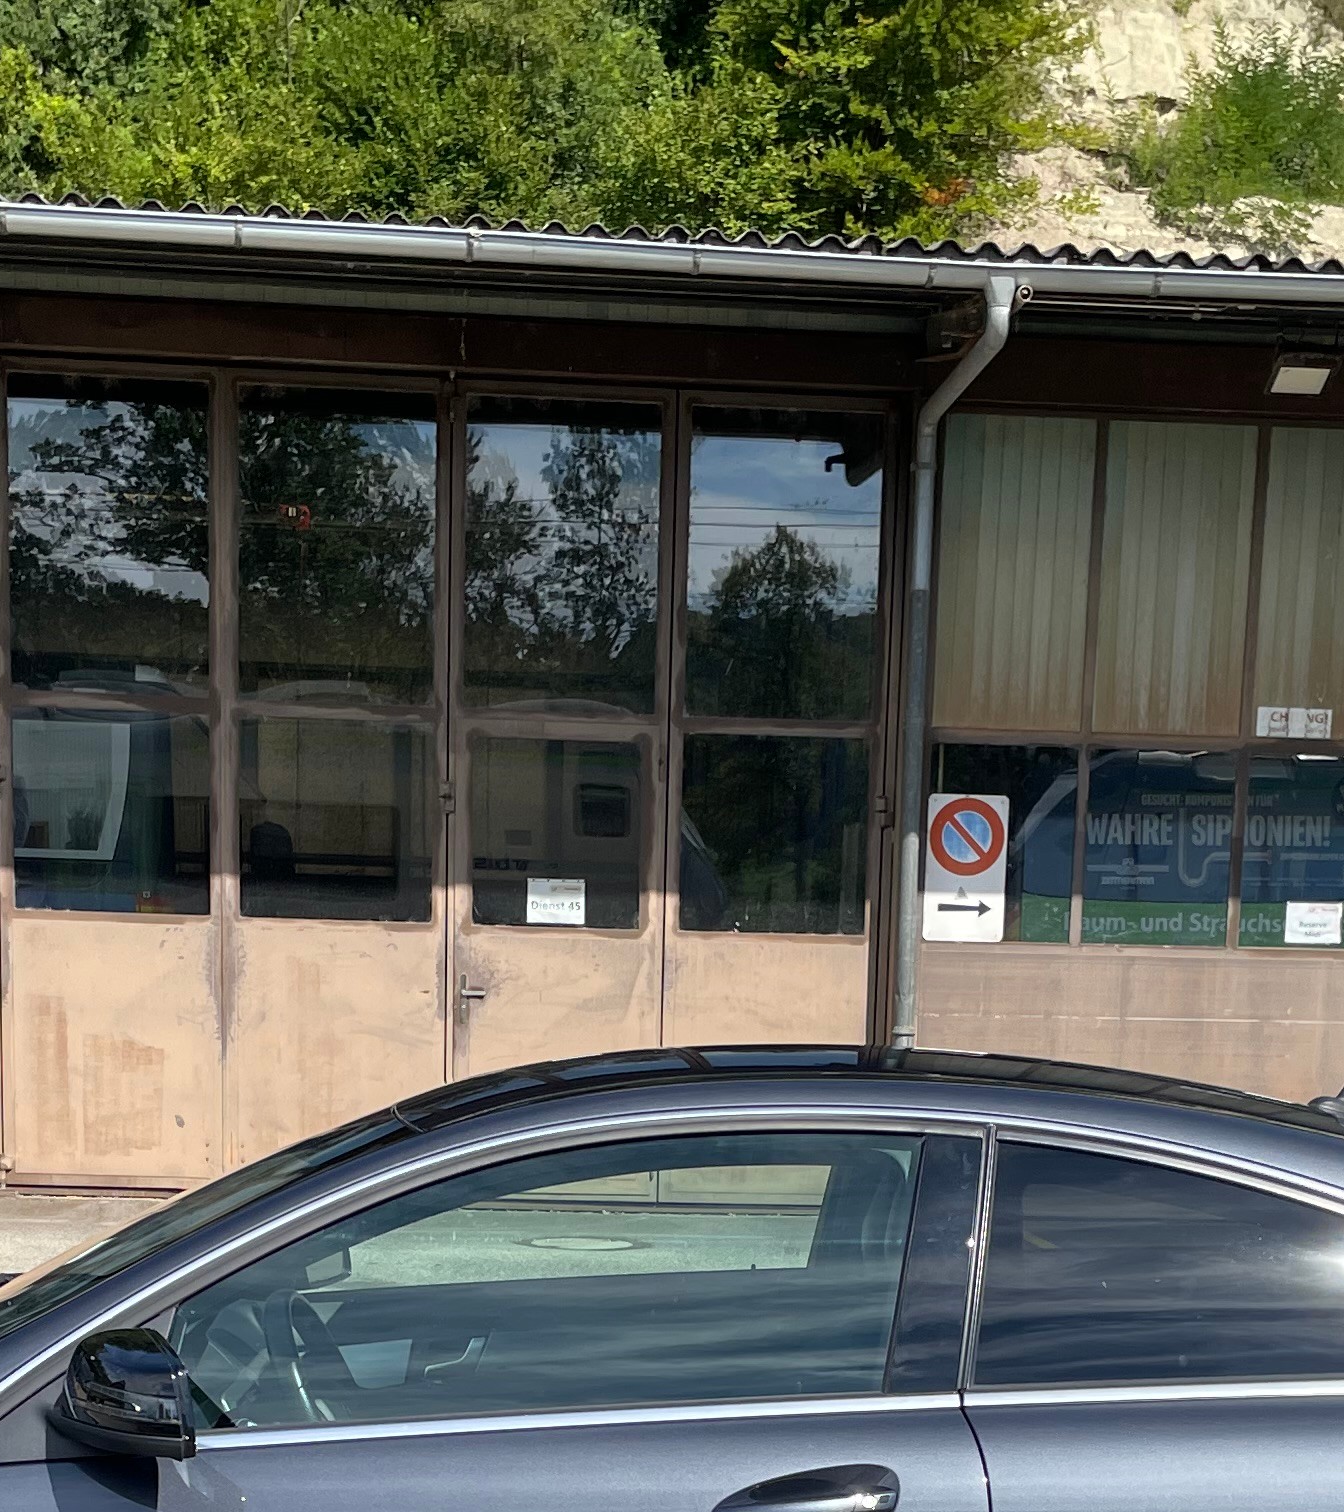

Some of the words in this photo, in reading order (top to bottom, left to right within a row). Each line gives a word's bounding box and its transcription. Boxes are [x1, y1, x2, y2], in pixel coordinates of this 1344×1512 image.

[1086, 812, 1175, 847] WAHRE
[1192, 813, 1332, 848] SIPONIEN!
[531, 900, 565, 911] Dienst
[567, 901, 581, 913] 45
[1140, 912, 1184, 933] und
